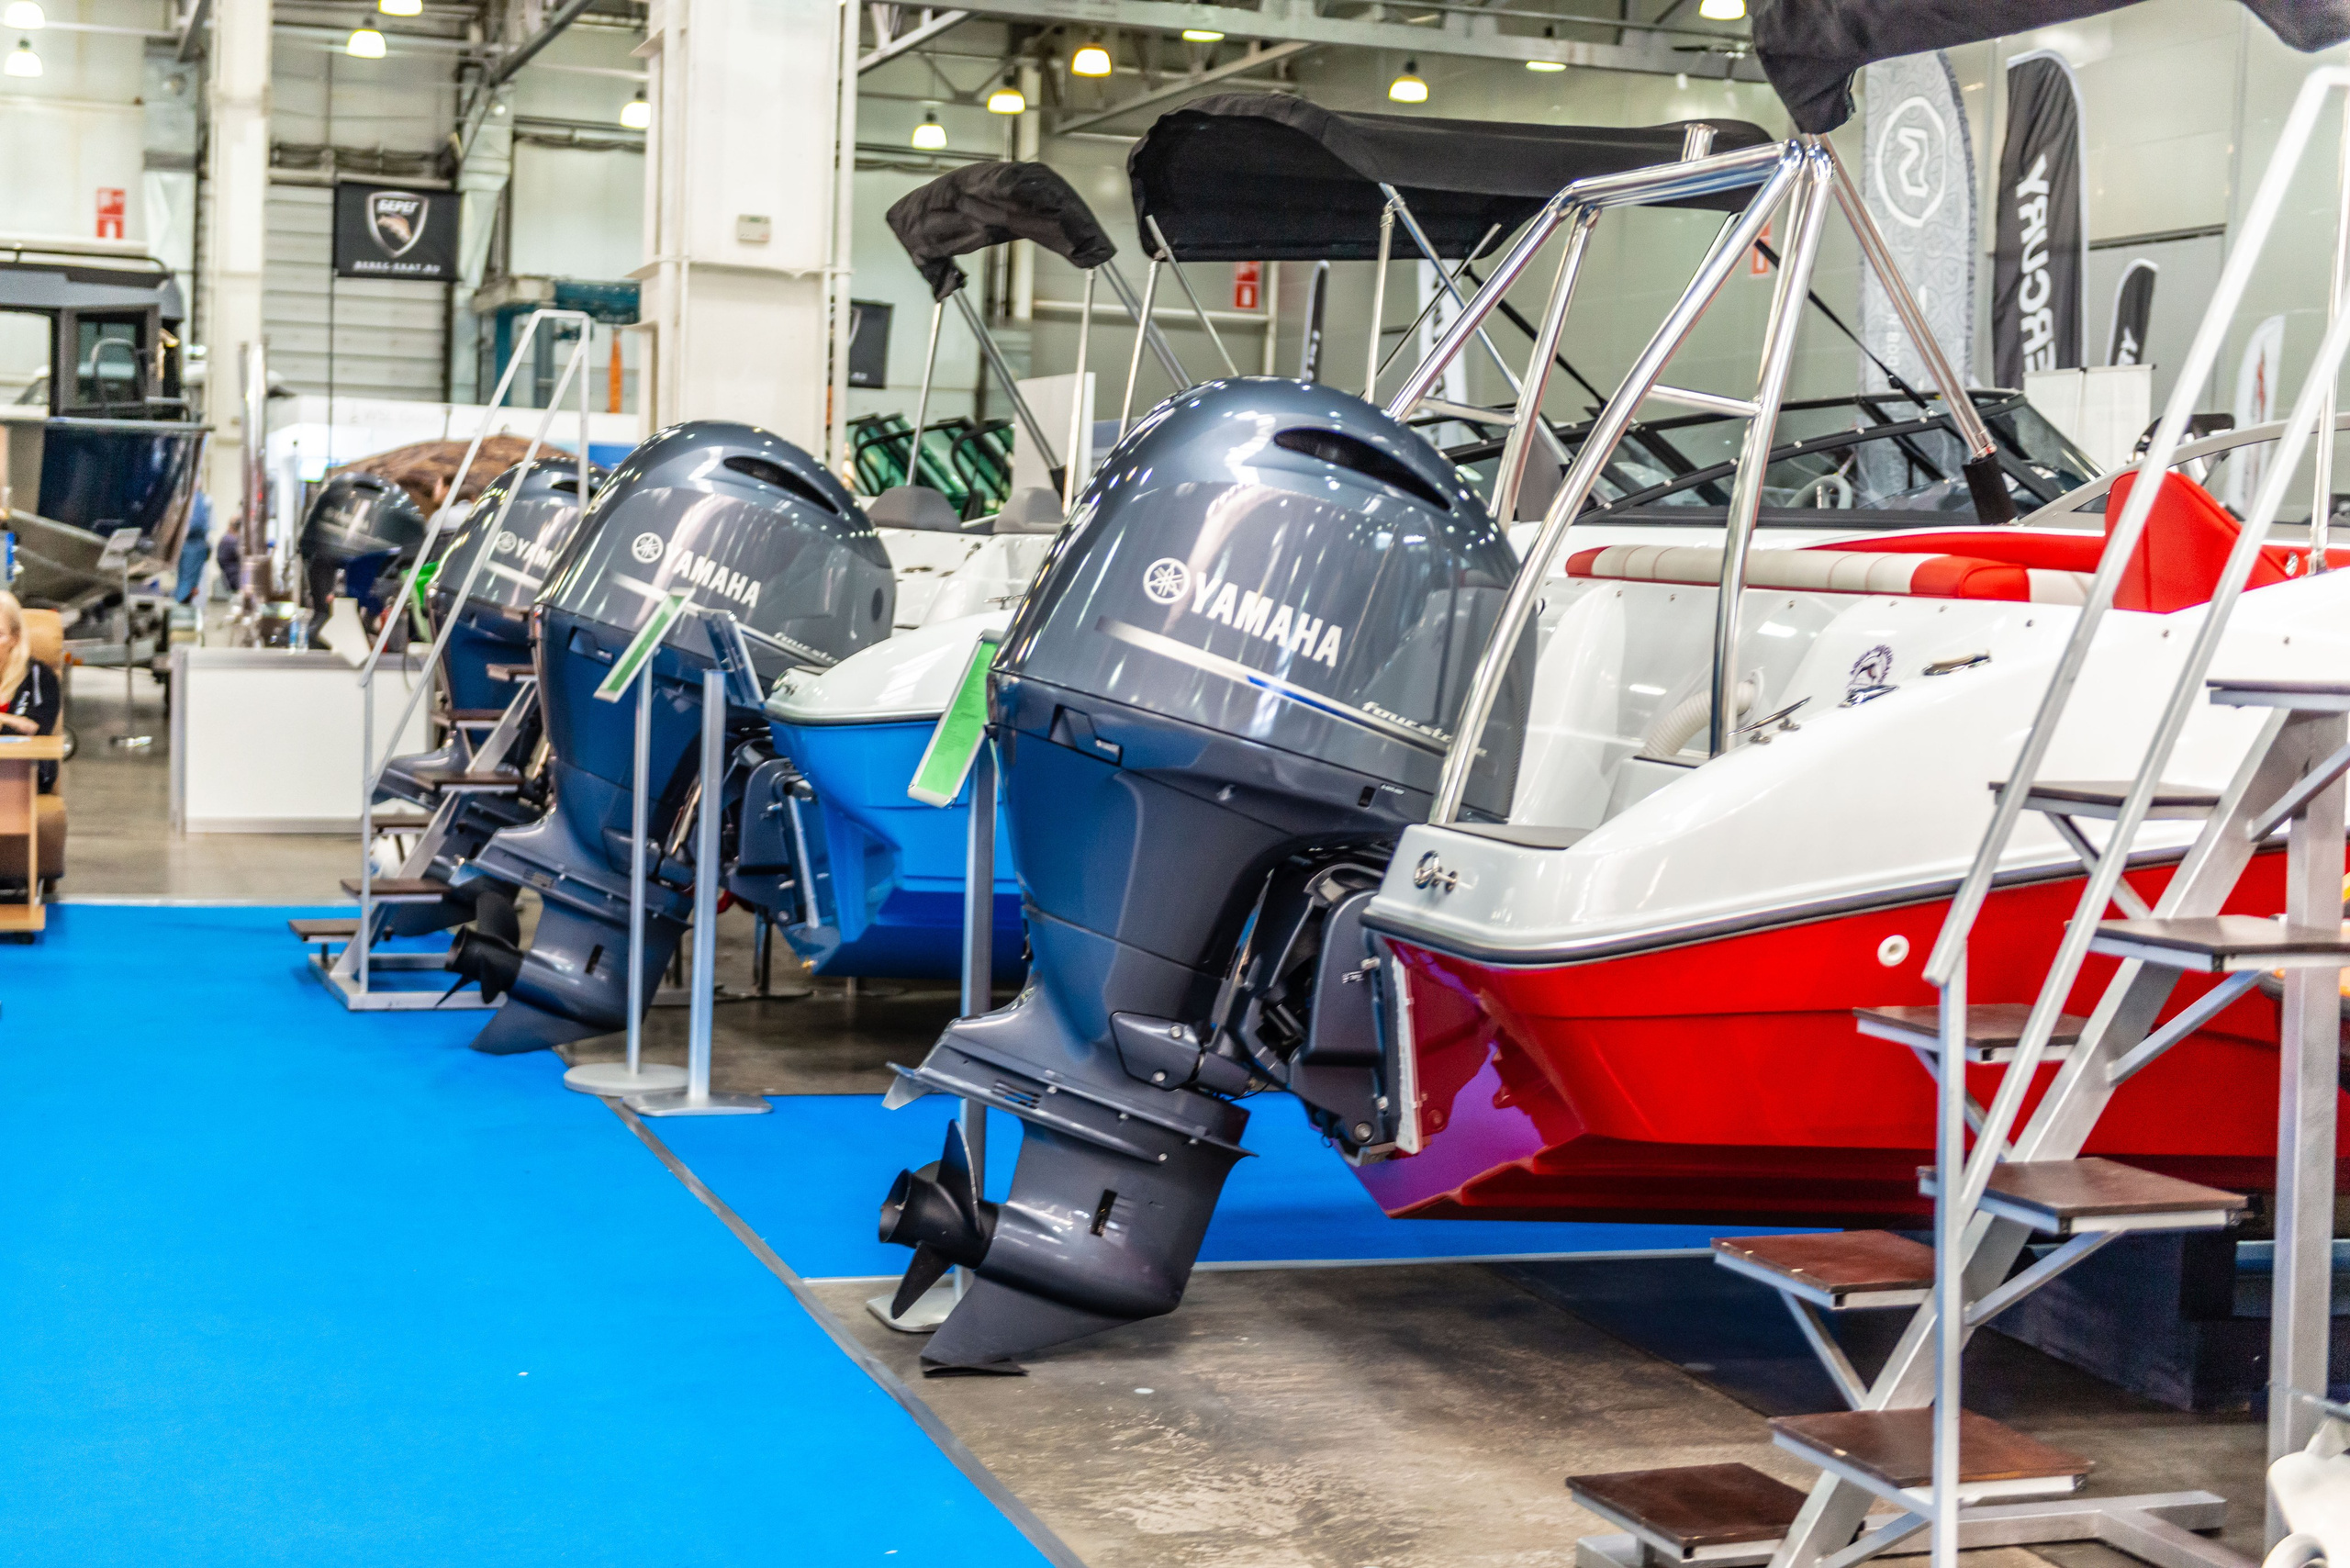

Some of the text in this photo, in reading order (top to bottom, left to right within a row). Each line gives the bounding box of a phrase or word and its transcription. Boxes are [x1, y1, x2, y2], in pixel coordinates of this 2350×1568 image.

[514, 537, 554, 570] YAM
[666, 542, 762, 609] YAMAHA
[1192, 571, 1343, 667] YAMAHA
